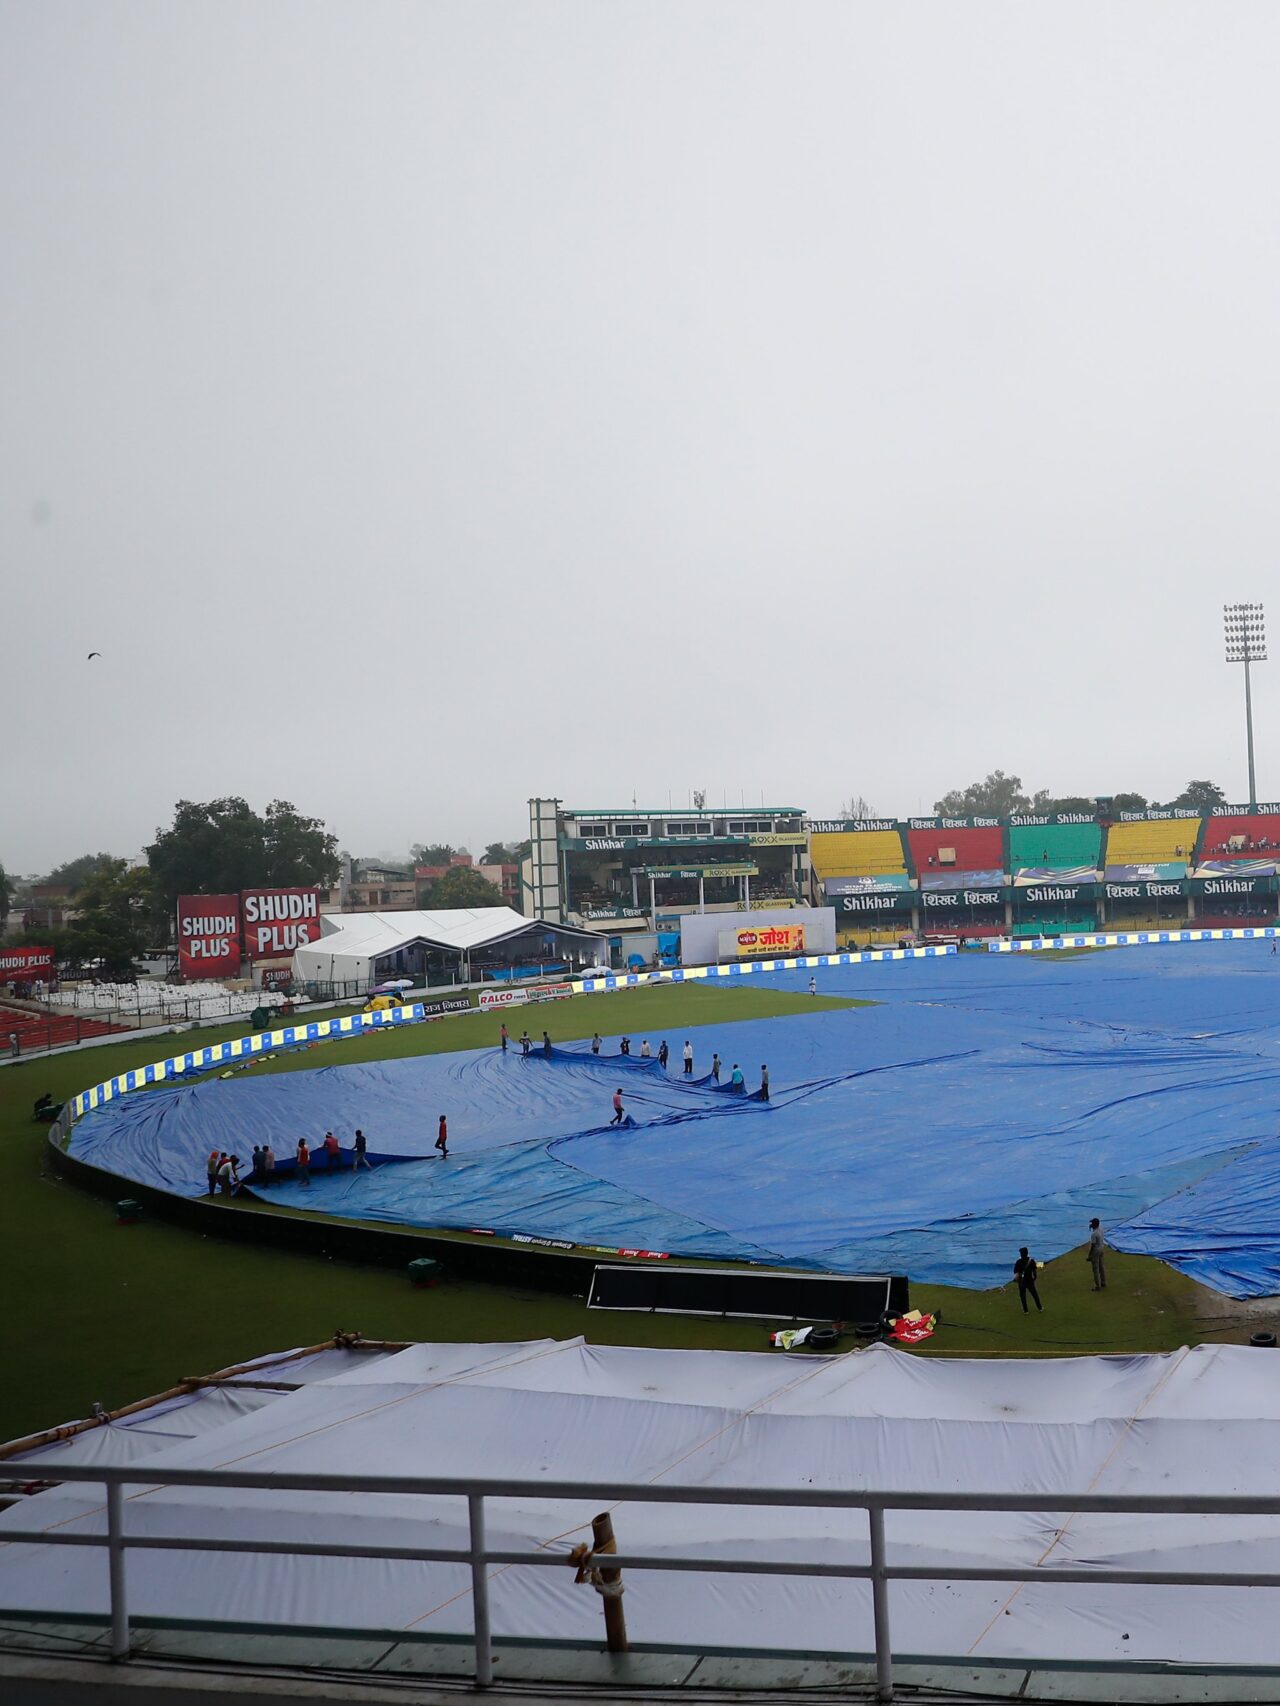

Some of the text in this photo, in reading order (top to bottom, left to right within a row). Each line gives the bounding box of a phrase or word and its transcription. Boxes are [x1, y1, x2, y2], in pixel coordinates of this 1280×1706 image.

[1212, 805, 1249, 816] Shikhar
[805, 820, 894, 832] Shikhar Shikhar
[1010, 813, 1094, 826] Shikhar Shikhar
[585, 839, 625, 850] Shikhar
[1026, 887, 1078, 901] Shikhar
[1106, 882, 1181, 898] शिखर शिखर
[1204, 880, 1254, 894] Shikhar
[843, 896, 897, 911] Shikhar
[922, 891, 999, 906] शिखर शिखर
[246, 893, 317, 922] SHUDH
[588, 910, 617, 918] Shikhar
[182, 916, 236, 936] SHUDH
[258, 924, 310, 952] PLUS
[759, 928, 789, 945] जोश
[190, 938, 229, 958] PLUS
[28, 955, 50, 965] PLUS
[266, 970, 290, 982] SHUDH
[480, 993, 513, 1004] RALCO
[425, 999, 469, 1013] राज निवास
